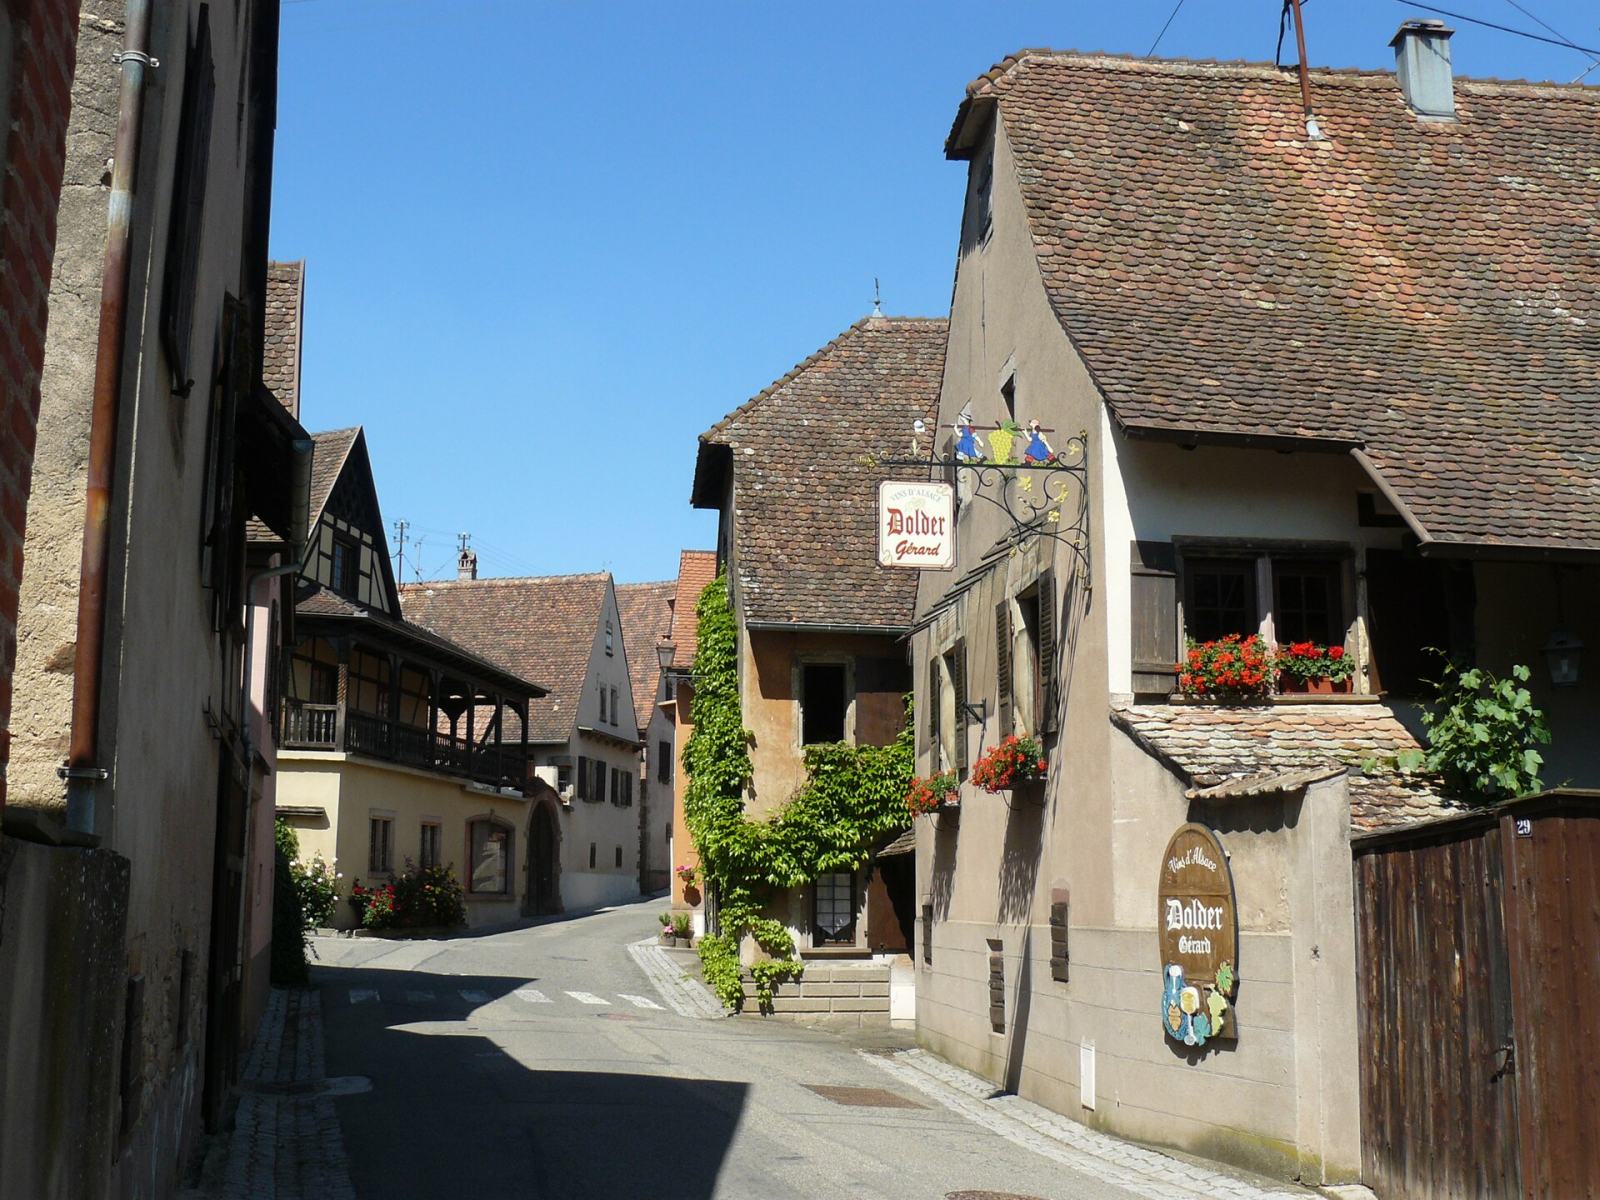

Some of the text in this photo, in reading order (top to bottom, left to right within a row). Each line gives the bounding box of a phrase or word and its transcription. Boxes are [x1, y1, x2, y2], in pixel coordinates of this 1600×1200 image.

[891, 489, 907, 501] VINS
[887, 507, 945, 537] Dolder
[895, 539, 941, 561] Gérard
[1516, 819, 1531, 835] 29
[1168, 846, 1217, 873] Vins d'Alsace
[1166, 898, 1223, 931] Dolder
[1178, 935, 1211, 954] Gérard
